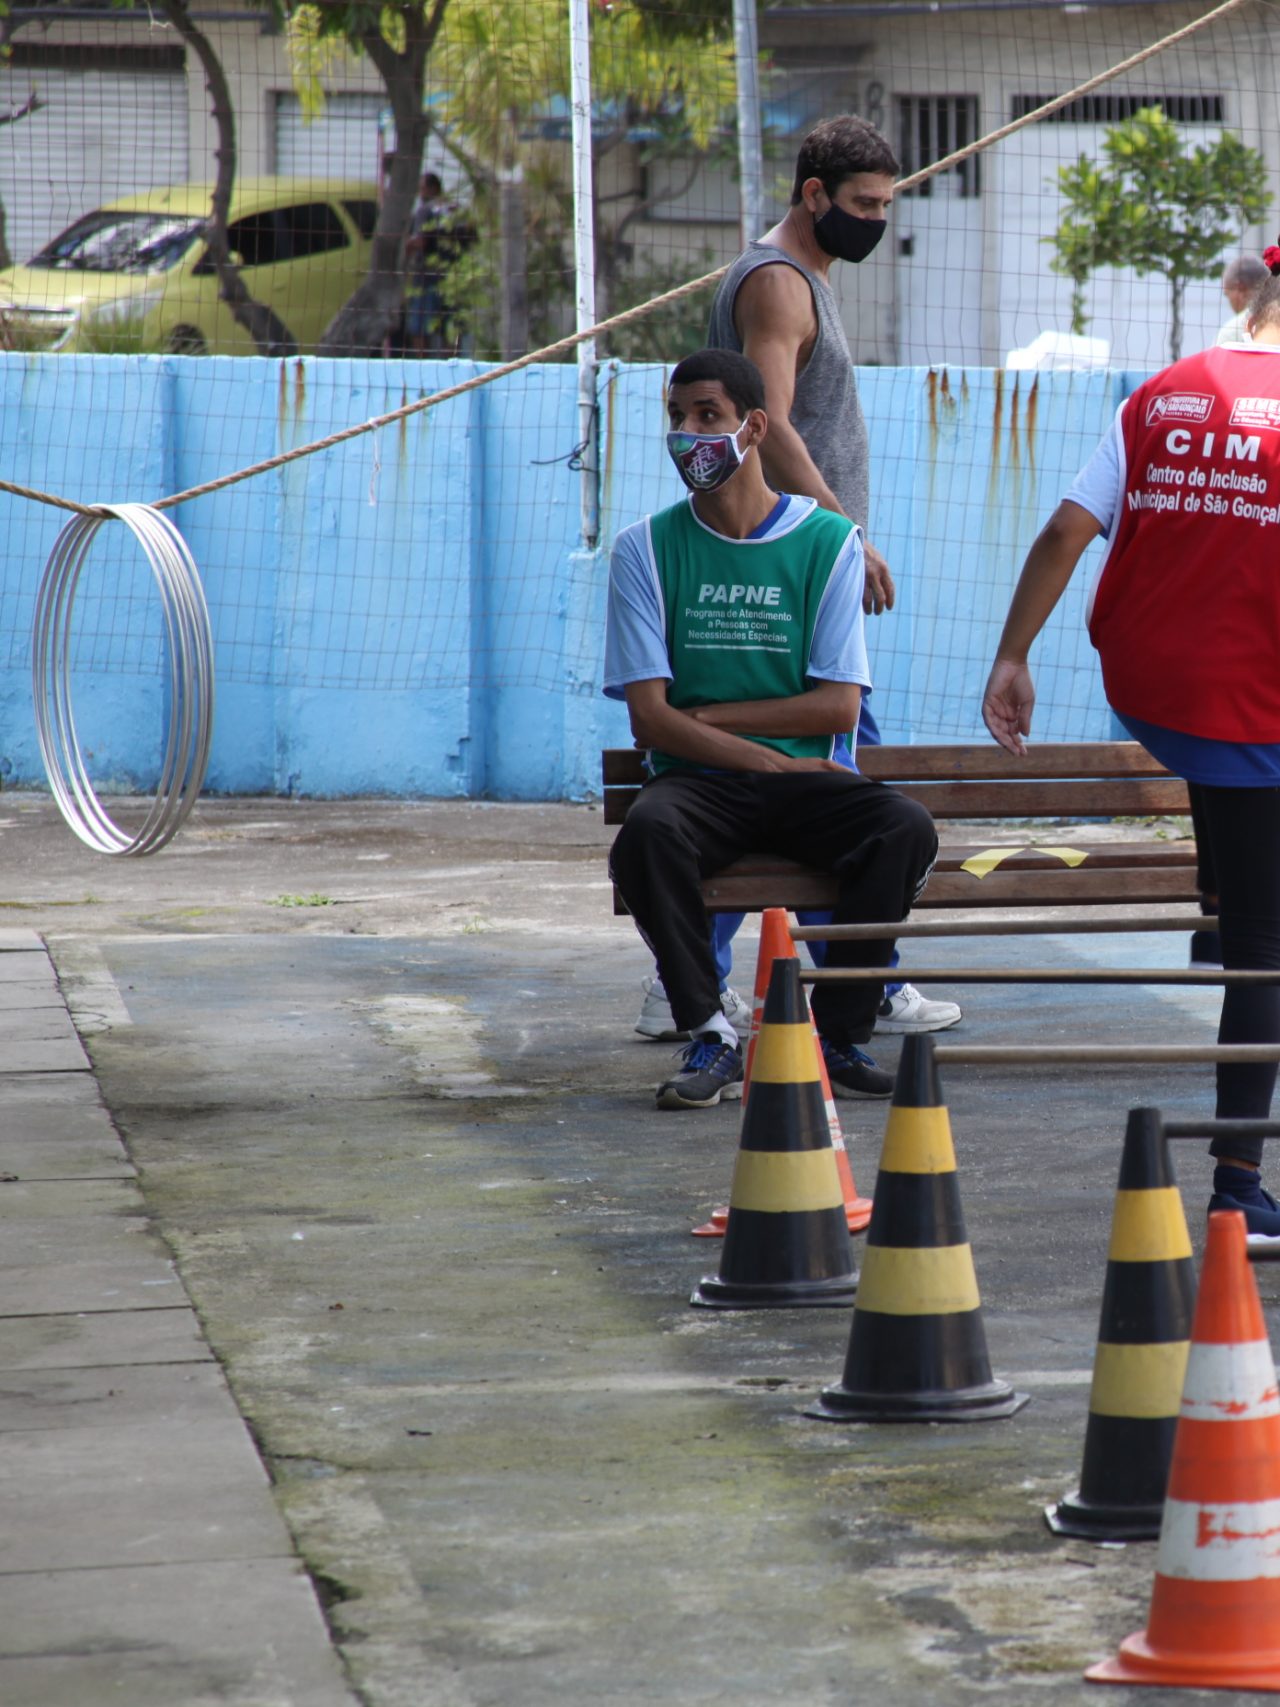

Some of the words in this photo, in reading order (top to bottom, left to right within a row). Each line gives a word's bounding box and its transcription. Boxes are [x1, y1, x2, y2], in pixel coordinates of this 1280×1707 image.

[1166, 429, 1261, 462] CIM
[1146, 462, 1185, 486] Centro
[1188, 466, 1206, 488] de
[1209, 467, 1268, 495] Inclusão
[1127, 488, 1181, 513] Municipal
[1184, 491, 1200, 513] de
[1203, 492, 1229, 516] São
[697, 583, 782, 606] PAPNE
[685, 607, 726, 620] Programa
[727, 608, 738, 618] de
[739, 608, 792, 622] Atendimento
[715, 619, 749, 630] Pessoas
[750, 622, 769, 630] com
[688, 629, 747, 641] Necessidades
[748, 630, 788, 643] Especiais
